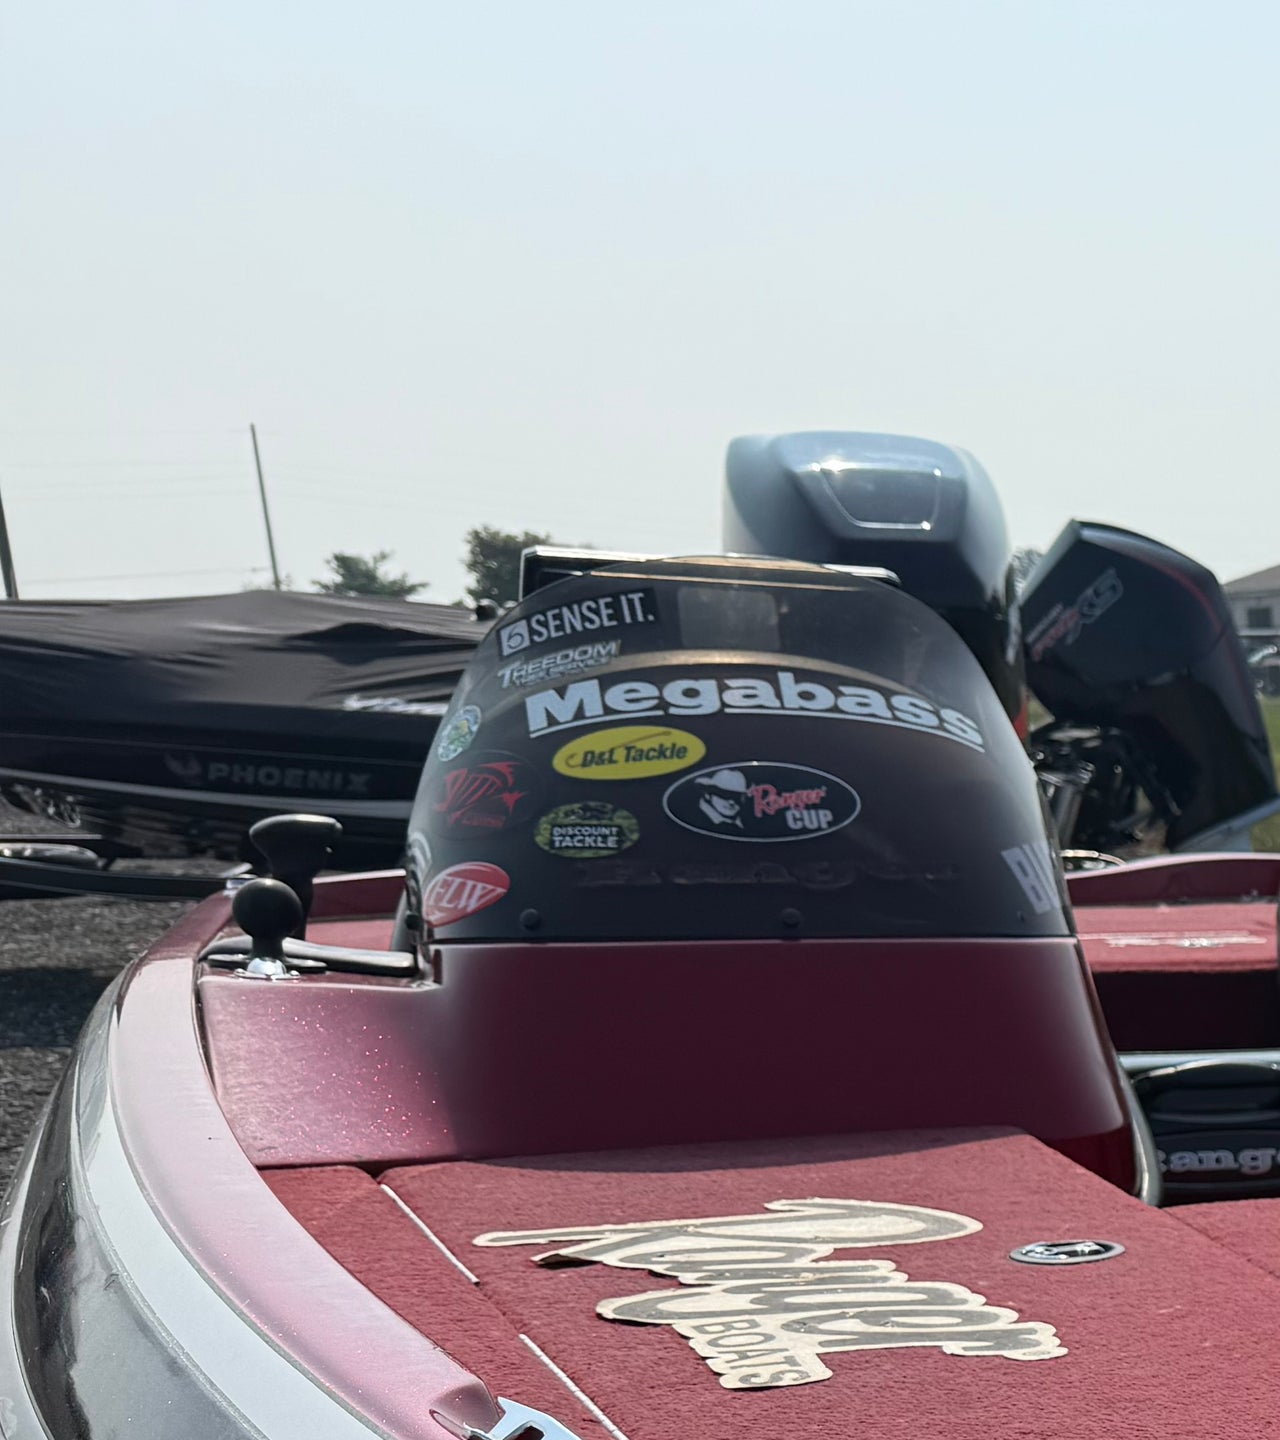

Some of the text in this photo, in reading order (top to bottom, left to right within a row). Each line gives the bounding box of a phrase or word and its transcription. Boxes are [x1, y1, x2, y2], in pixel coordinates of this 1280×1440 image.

[530, 597, 618, 642] SENSE
[619, 592, 655, 624] IT.
[525, 671, 985, 752] Megabass
[580, 742, 688, 769] D&L Tackle
[207, 762, 372, 792] PHOENIX
[747, 784, 827, 818] Ranger
[552, 826, 619, 836] DISCOUNT
[785, 808, 834, 830] CUP
[552, 836, 619, 848] TACKLE
[430, 876, 506, 912] FLW
[474, 1199, 1068, 1359] Ranger
[695, 1316, 812, 1388] BOATS
